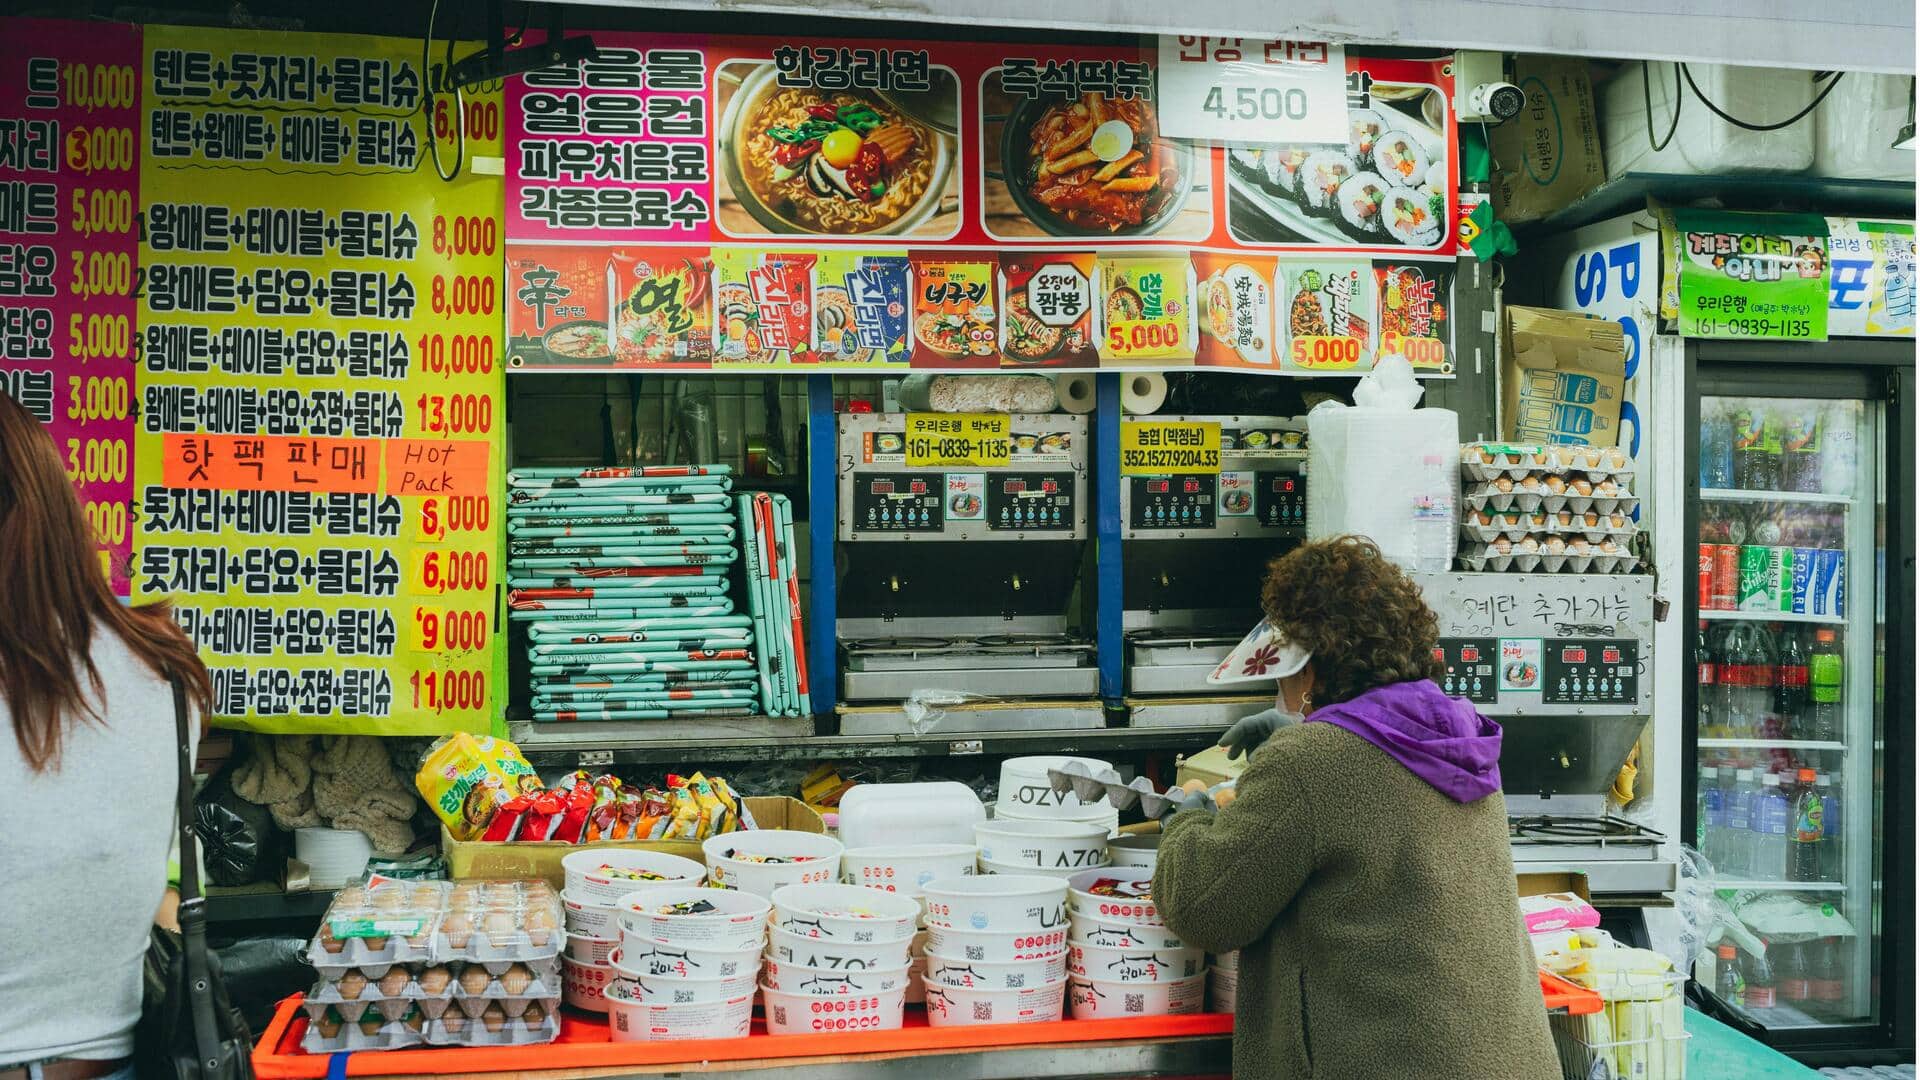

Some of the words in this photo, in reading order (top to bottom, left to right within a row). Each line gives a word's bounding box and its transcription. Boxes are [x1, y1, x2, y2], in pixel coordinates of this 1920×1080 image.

[63, 63, 135, 114] 10,000
[152, 49, 420, 109] 텐트+돗자리+물티슈
[773, 45, 930, 92] 한강라면
[1001, 57, 1158, 101] 즉석떡볶
[520, 91, 707, 138] 얼음컵
[66, 126, 134, 177] 3,000
[518, 140, 710, 184] 파우치음료
[71, 188, 132, 239] 5,000
[520, 187, 711, 231] 각종음료수
[149, 203, 418, 260] 왕매트+테이블+물티슈
[431, 215, 497, 262] 8,000
[69, 250, 131, 301] 3,000
[130, 267, 148, 299] 2
[147, 263, 416, 320] 왕매트+담요+물티슈
[430, 274, 496, 321] 8,000
[1037, 274, 1078, 290] 오징어
[1723, 257, 1783, 282] 안내
[517, 264, 572, 330] 辛
[630, 276, 693, 334] 열
[925, 280, 988, 306] 너구리
[1036, 292, 1082, 317] 짬뽕
[1696, 295, 1748, 313] 우리은행
[0, 307, 54, 359] 담요
[68, 313, 130, 364] 5,000
[128, 331, 145, 364] 3
[1109, 322, 1180, 353] 5,000
[1384, 332, 1446, 364] 5000
[1695, 318, 1811, 337] 161-0839-1135
[146, 324, 409, 380] 왕매트+테이블+담요+물티슈
[418, 333, 494, 381] 10,000
[1292, 338, 1361, 367] 5,000
[66, 375, 128, 426] 3,000
[128, 396, 142, 426] 4
[144, 385, 404, 439] 왕매트+테이블+담요+조명+물티슈
[416, 392, 492, 439] 13,000
[909, 438, 1009, 459] 161-0839-1135
[914, 419, 962, 433] 우리은행
[1137, 427, 1160, 446] 농협
[1163, 427, 1205, 447] (박정남)
[66, 437, 128, 488] 3,000
[1123, 449, 1219, 468] 352.1527.9204.33
[143, 488, 401, 536] 돗자리+테이블+물티슈
[420, 496, 490, 541] 6,000
[142, 546, 400, 595] 돗자리+담요+물티슈
[422, 550, 489, 595] 6,000
[410, 669, 485, 717] 11,000
